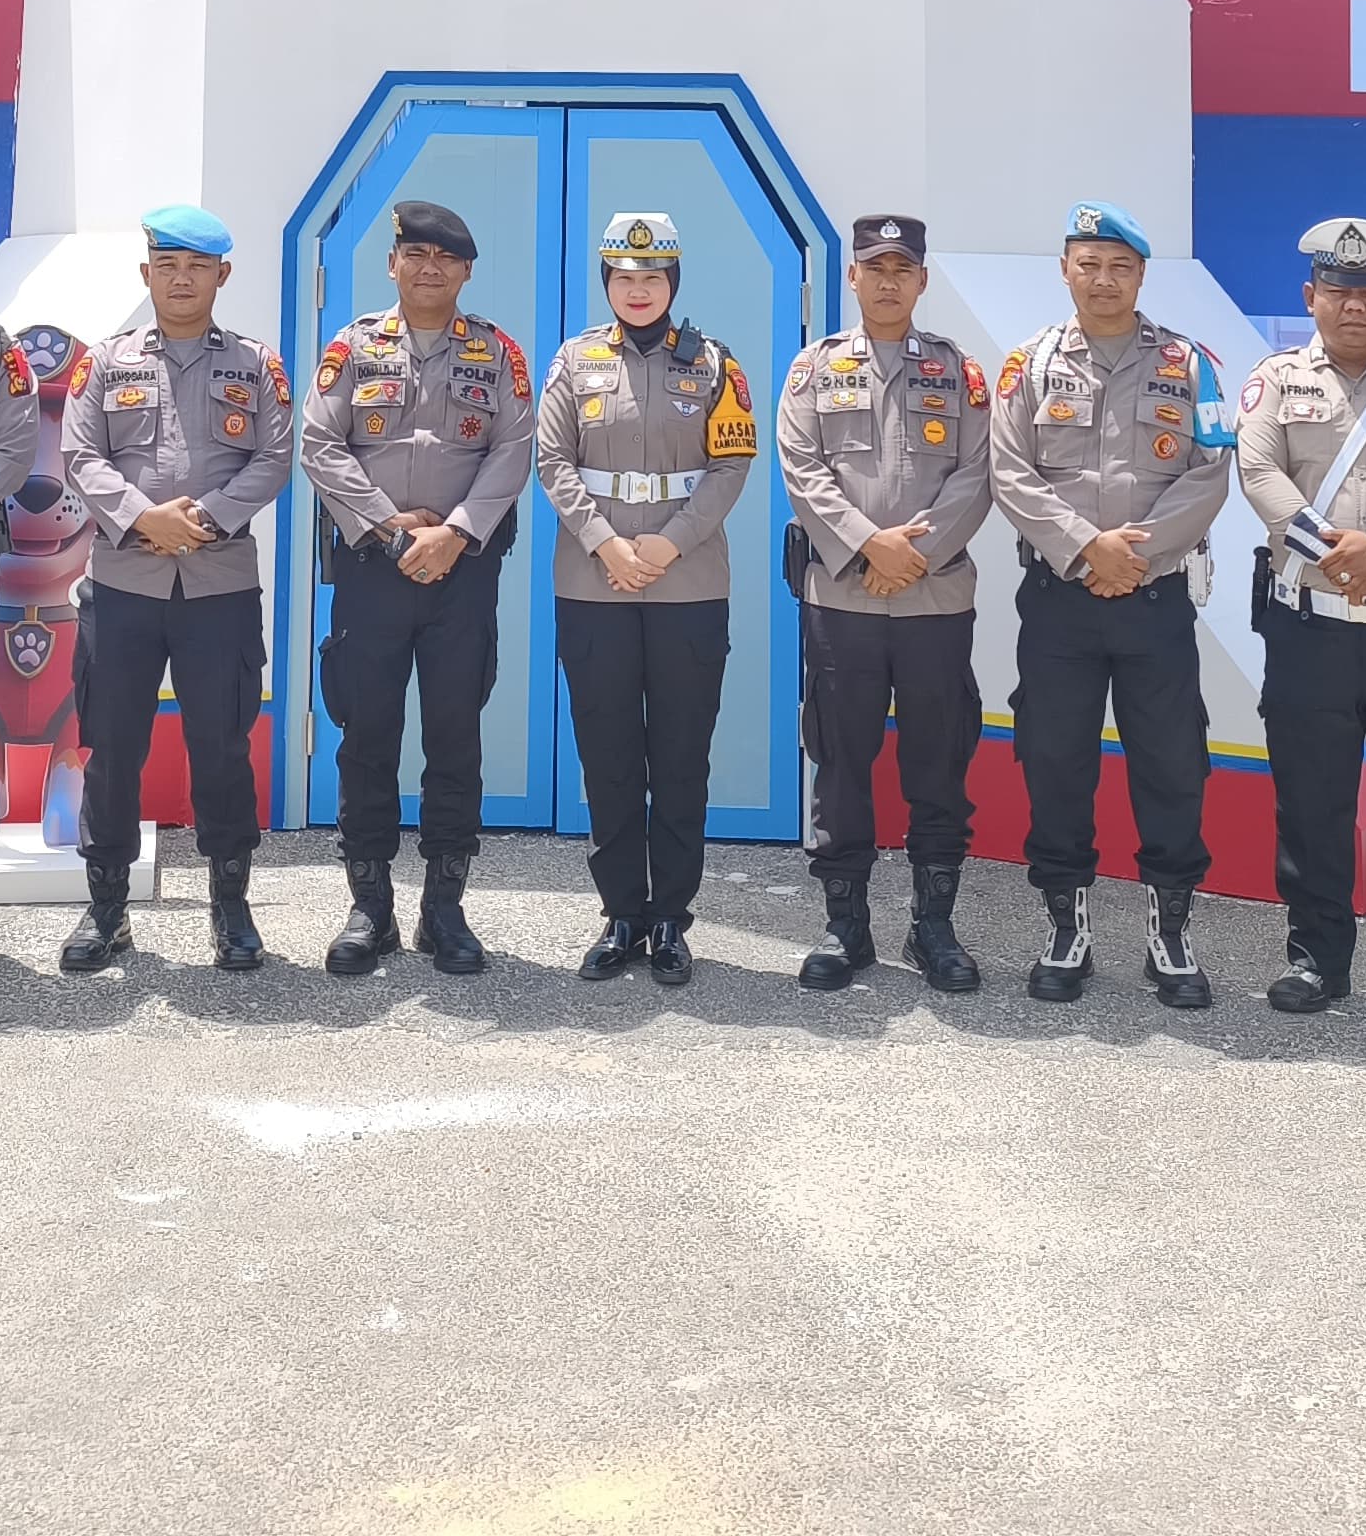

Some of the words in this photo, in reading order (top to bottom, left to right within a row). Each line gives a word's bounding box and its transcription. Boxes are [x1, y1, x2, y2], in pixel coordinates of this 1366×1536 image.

[577, 362, 618, 372] SHANDRA
[667, 366, 709, 377] POLRI
[212, 369, 259, 386] POLRI
[452, 366, 496, 385] POLRI
[908, 378, 956, 391] POLRI
[1147, 381, 1191, 402] POLRI
